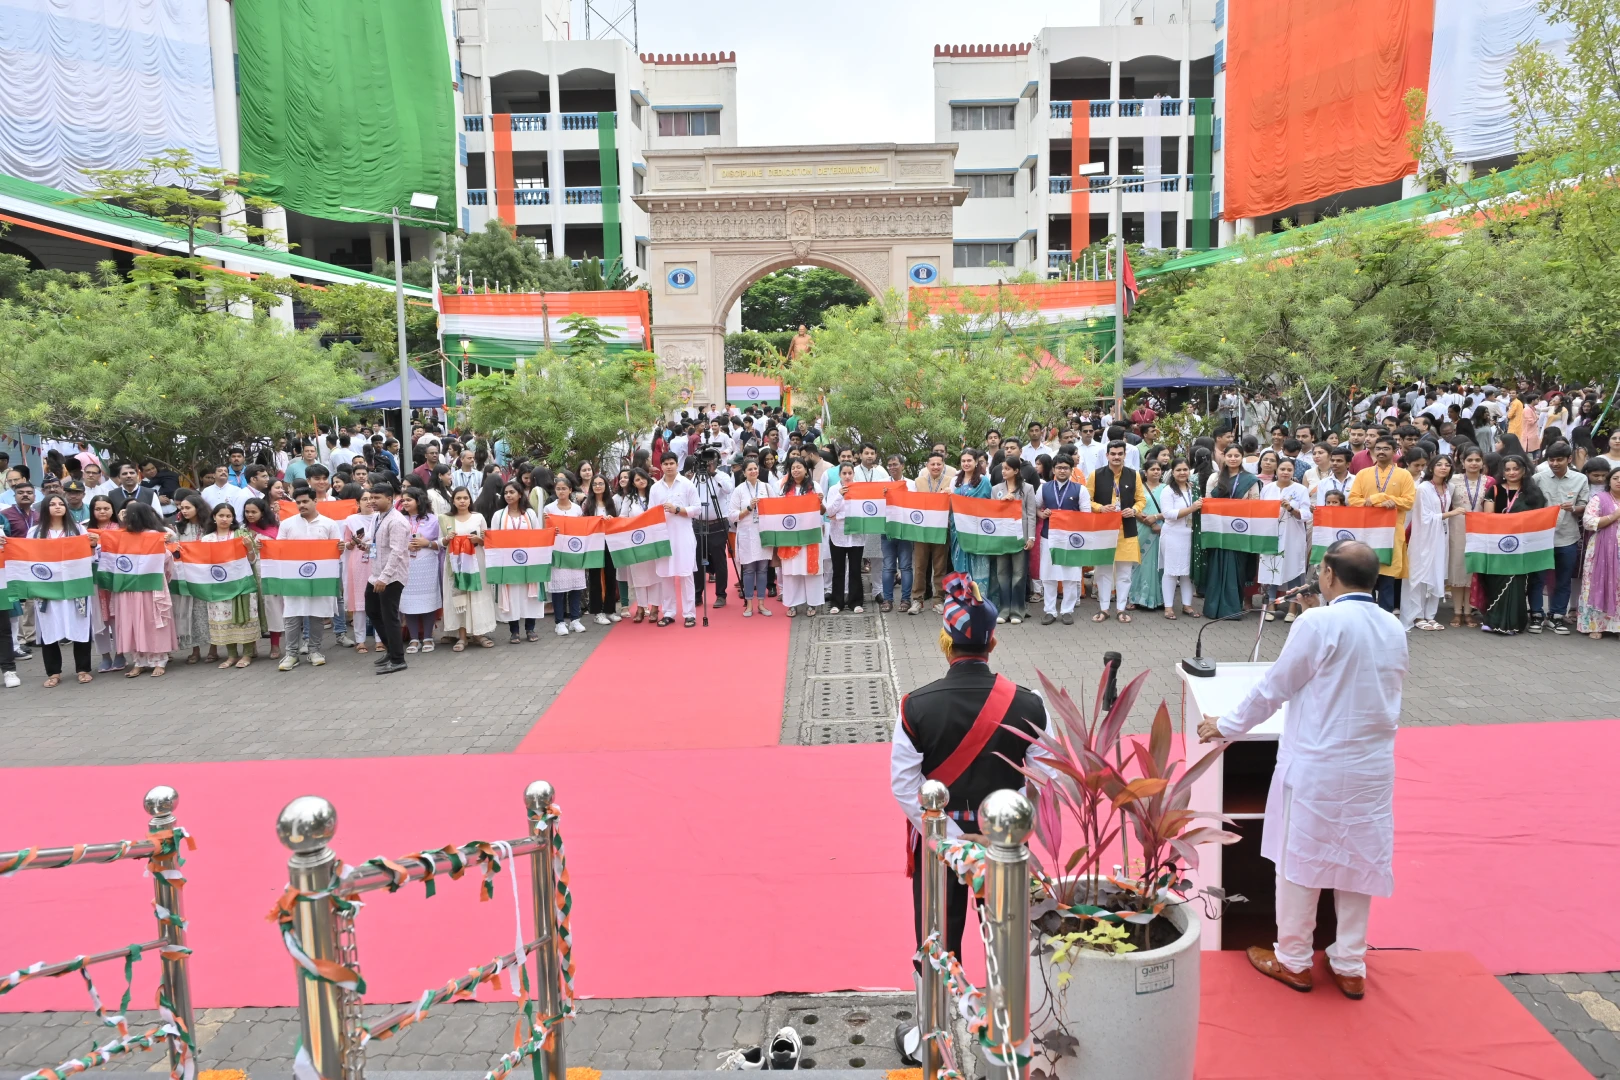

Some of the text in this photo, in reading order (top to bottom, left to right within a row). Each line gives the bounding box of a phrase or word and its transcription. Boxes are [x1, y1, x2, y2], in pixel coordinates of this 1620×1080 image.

[721, 165, 880, 178] DISCIPLINE DEDICATION DETERMINATION
